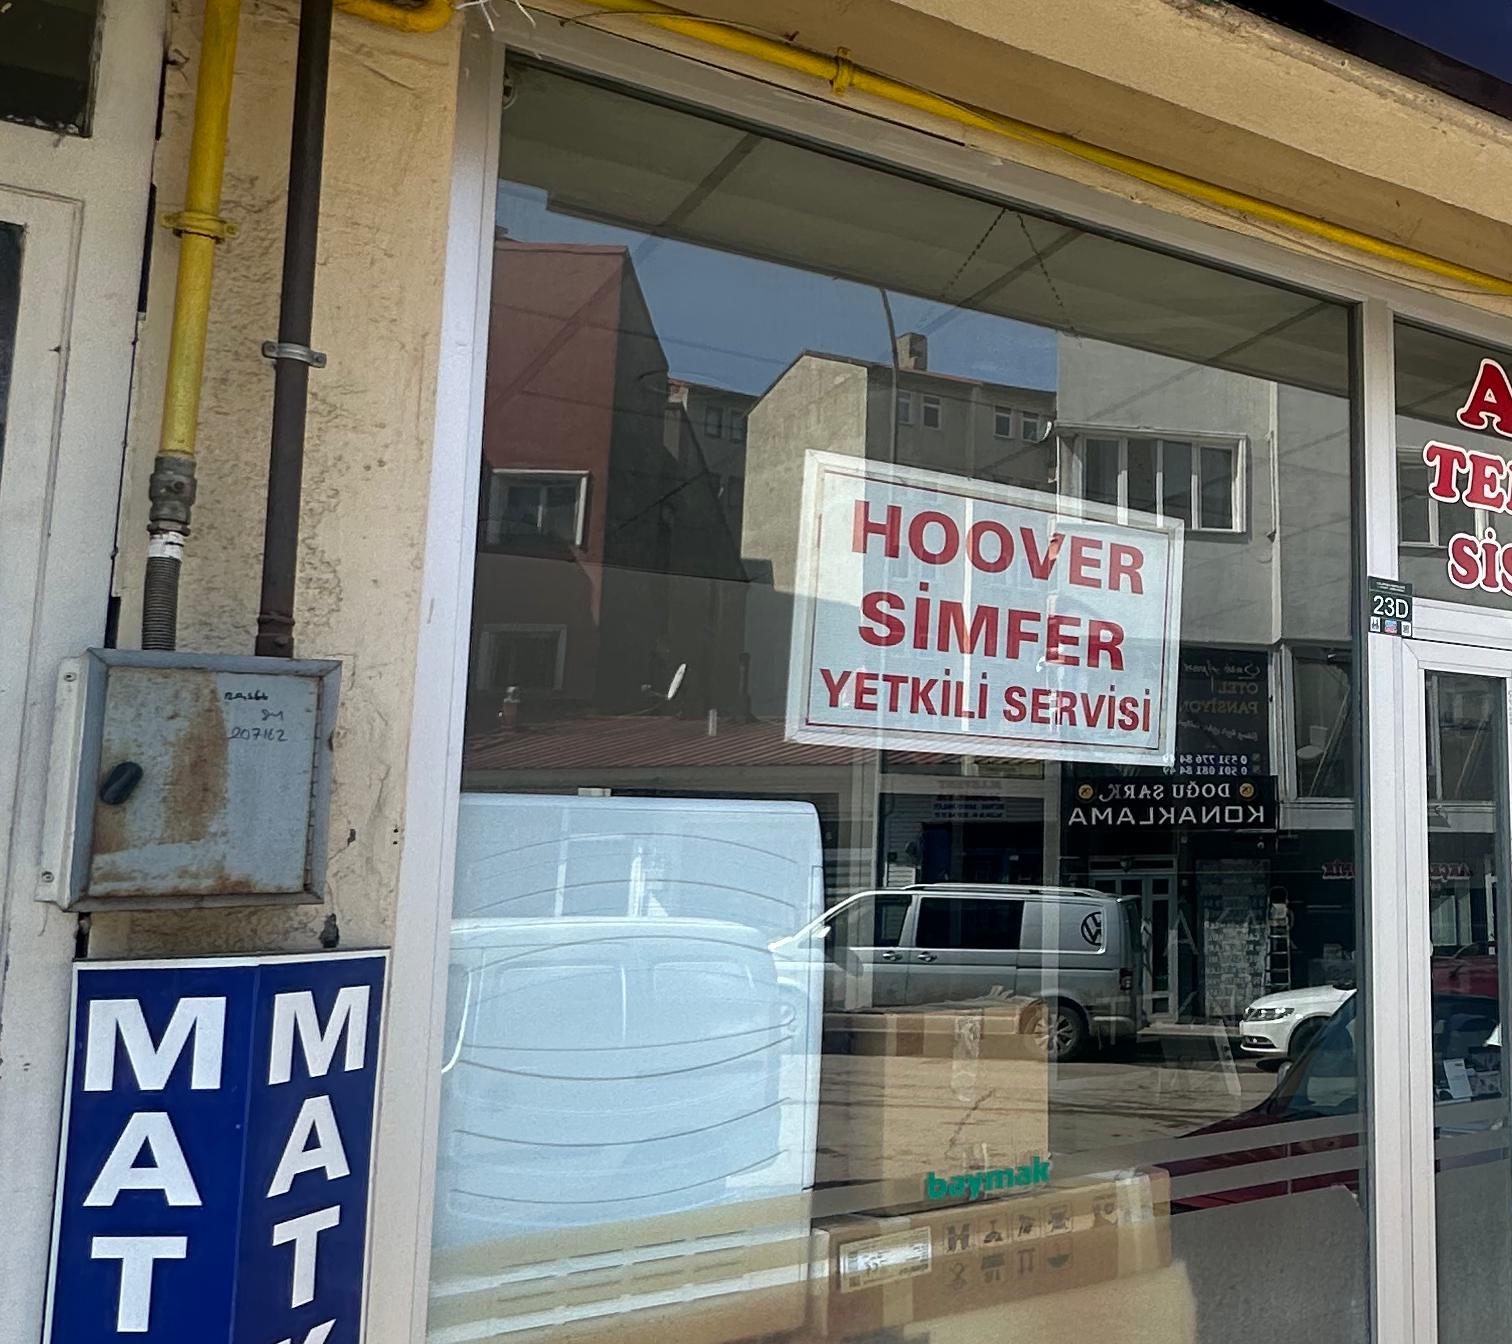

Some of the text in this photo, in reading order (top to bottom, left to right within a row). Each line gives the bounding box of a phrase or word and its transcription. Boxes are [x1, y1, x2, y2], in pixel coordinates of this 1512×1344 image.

[852, 499, 1145, 596] HOOVER
[858, 581, 1126, 672] SİMFER
[1373, 595, 1409, 619] 23D
[819, 667, 989, 720] YETKİLİ
[1003, 683, 1152, 733] SERVİSİ
[927, 1156, 1052, 1200] baymak
